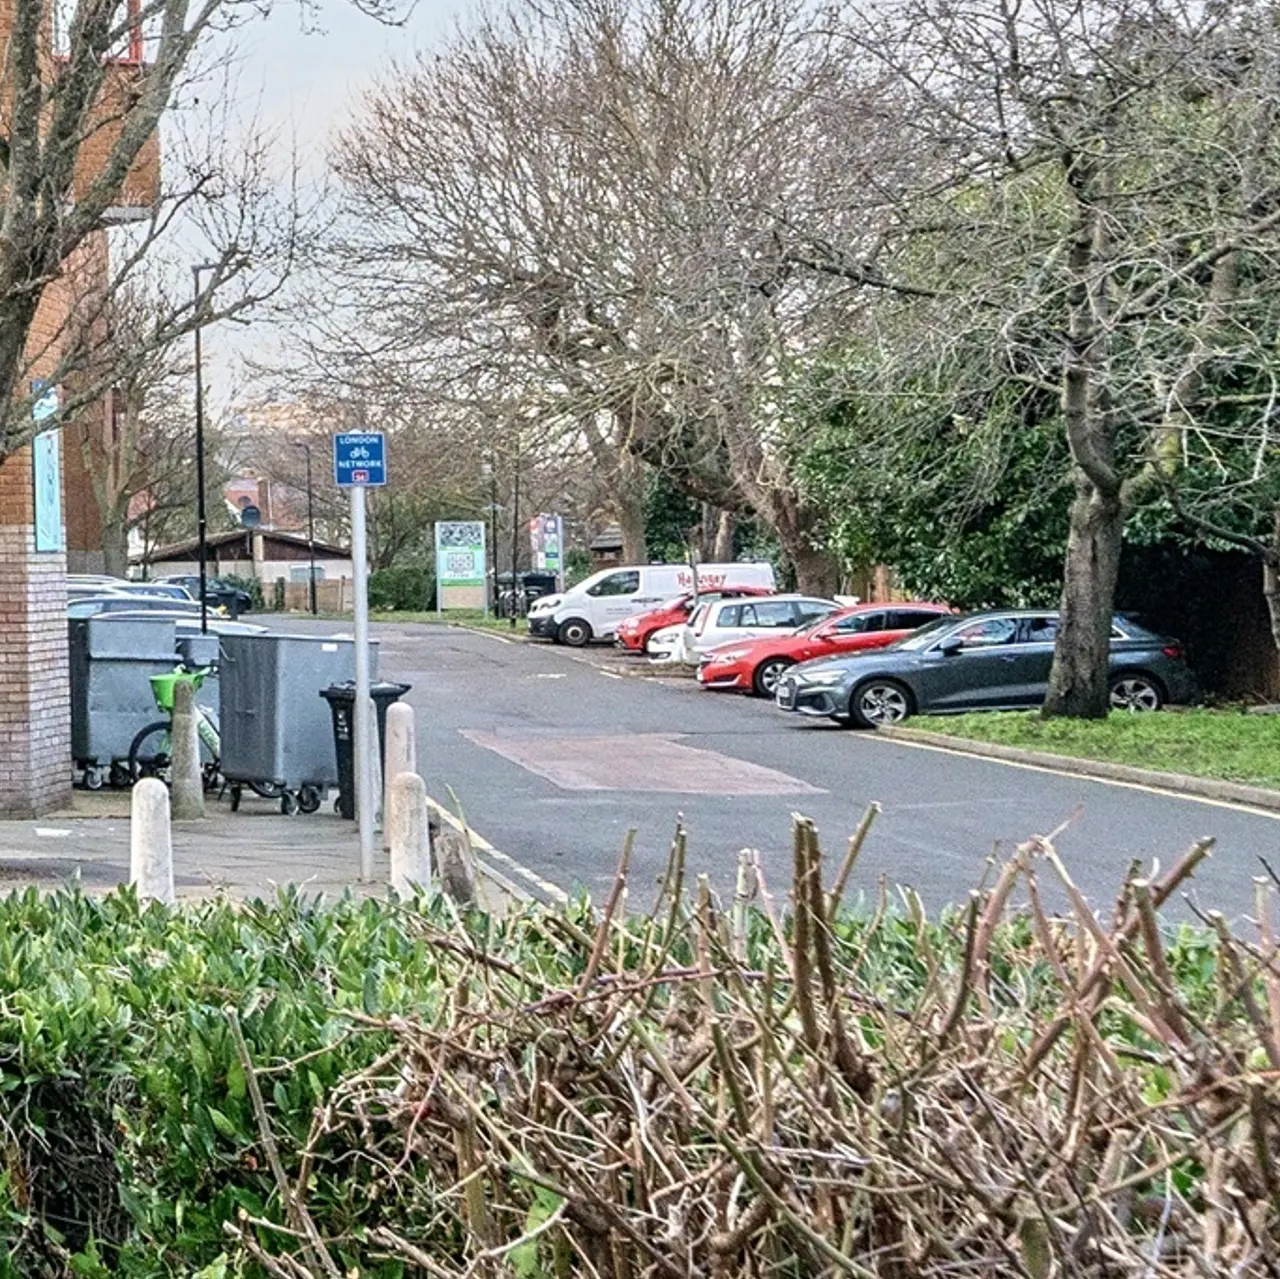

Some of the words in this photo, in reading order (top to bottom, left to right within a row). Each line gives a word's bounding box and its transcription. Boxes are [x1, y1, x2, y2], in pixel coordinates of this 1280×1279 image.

[339, 436, 379, 445] LONDON
[338, 460, 382, 469] NETWORK
[677, 571, 727, 588] Haingey
